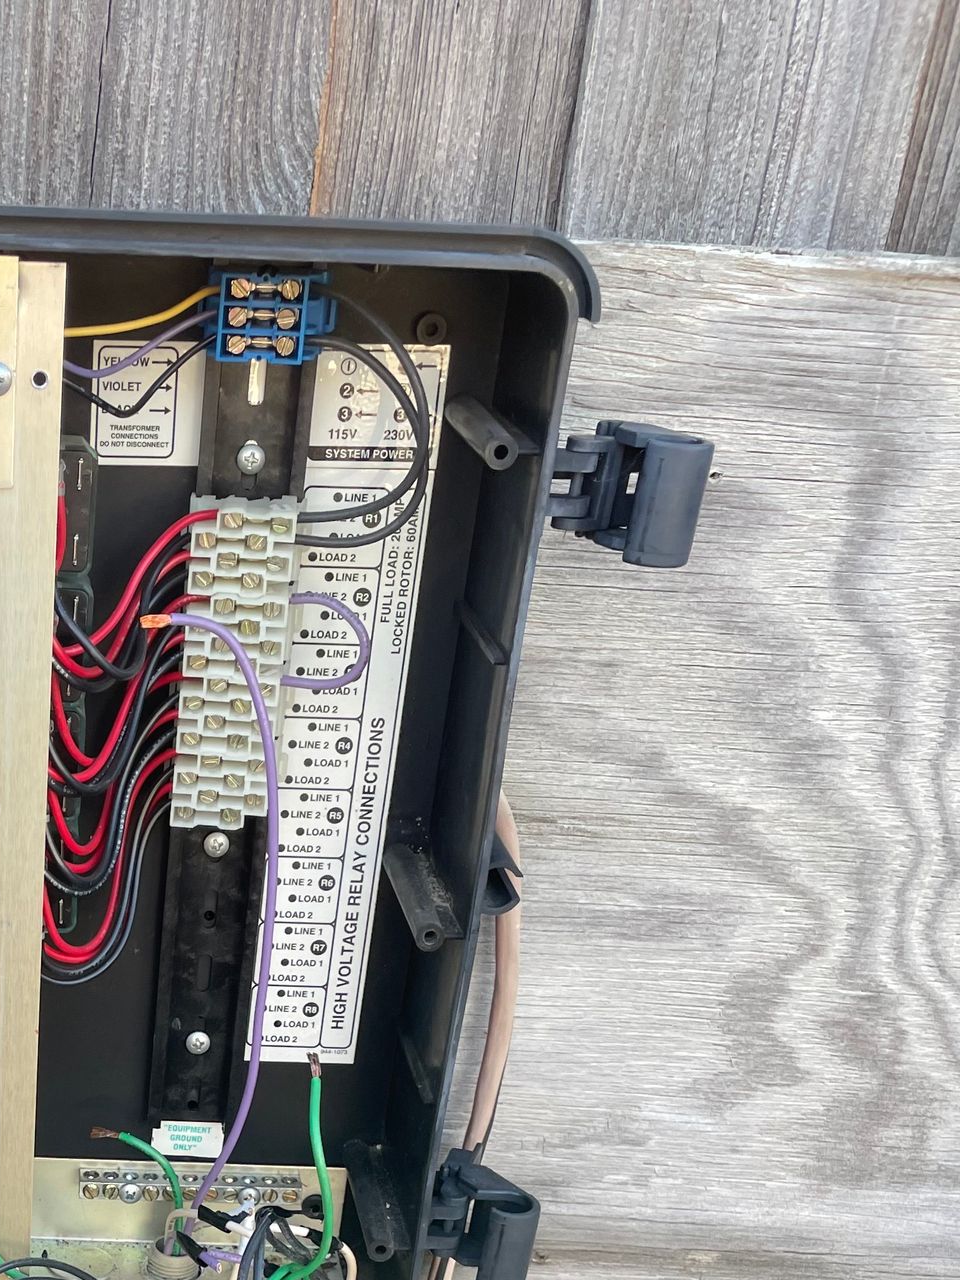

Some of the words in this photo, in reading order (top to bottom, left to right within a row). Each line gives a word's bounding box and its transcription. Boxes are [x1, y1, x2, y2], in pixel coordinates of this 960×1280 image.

[103, 356, 150, 367] YEOW
[102, 381, 142, 392] VIOLET
[328, 429, 358, 440] 115V
[384, 430, 414, 440] 230V
[325, 449, 370, 459] SYSTEM
[372, 450, 414, 459] POWER
[344, 493, 368, 502] LINE
[365, 514, 378, 523] R1
[318, 553, 348, 562] LOAD
[350, 554, 356, 562] 2
[385, 546, 400, 587] LOAD:
[336, 573, 359, 582] LINE
[340, 592, 346, 601] 2
[356, 592, 370, 602] R2
[391, 602, 407, 654] LOCKED
[399, 546, 416, 598] ROTOR:
[380, 589, 394, 623] FULL
[310, 630, 339, 639] LOAD
[340, 630, 347, 639] 2
[326, 649, 350, 658] LINE
[306, 668, 330, 676] LINE
[332, 668, 338, 676] 2
[322, 687, 351, 696] LOAD
[302, 704, 329, 713] LOAD
[332, 705, 338, 714] 2
[318, 723, 341, 732] LINE
[298, 741, 321, 749] LINE
[324, 742, 330, 750] 2
[337, 741, 350, 750] R4
[314, 758, 342, 767] LOAD
[294, 776, 322, 784] LOAD
[324, 776, 330, 784] 2
[356, 717, 385, 846] CONNECTIONS
[310, 794, 333, 802] LINE
[291, 810, 312, 818] LINE
[314, 811, 320, 819] 2
[329, 810, 342, 820] R5
[306, 828, 332, 836] LOAD
[287, 845, 312, 853] LOAD
[302, 862, 324, 870] LINE
[283, 878, 304, 886] LINE
[306, 878, 312, 886] 2
[321, 878, 334, 888] R6
[347, 851, 367, 906] RELAY
[298, 895, 324, 903] LOAD
[280, 911, 304, 919] LOAD
[313, 944, 326, 952] R7
[336, 911, 360, 988] VOLTAGE
[305, 1005, 318, 1014] R8
[331, 992, 348, 1030] HIGH
[170, 1134, 202, 1142] GROUND
